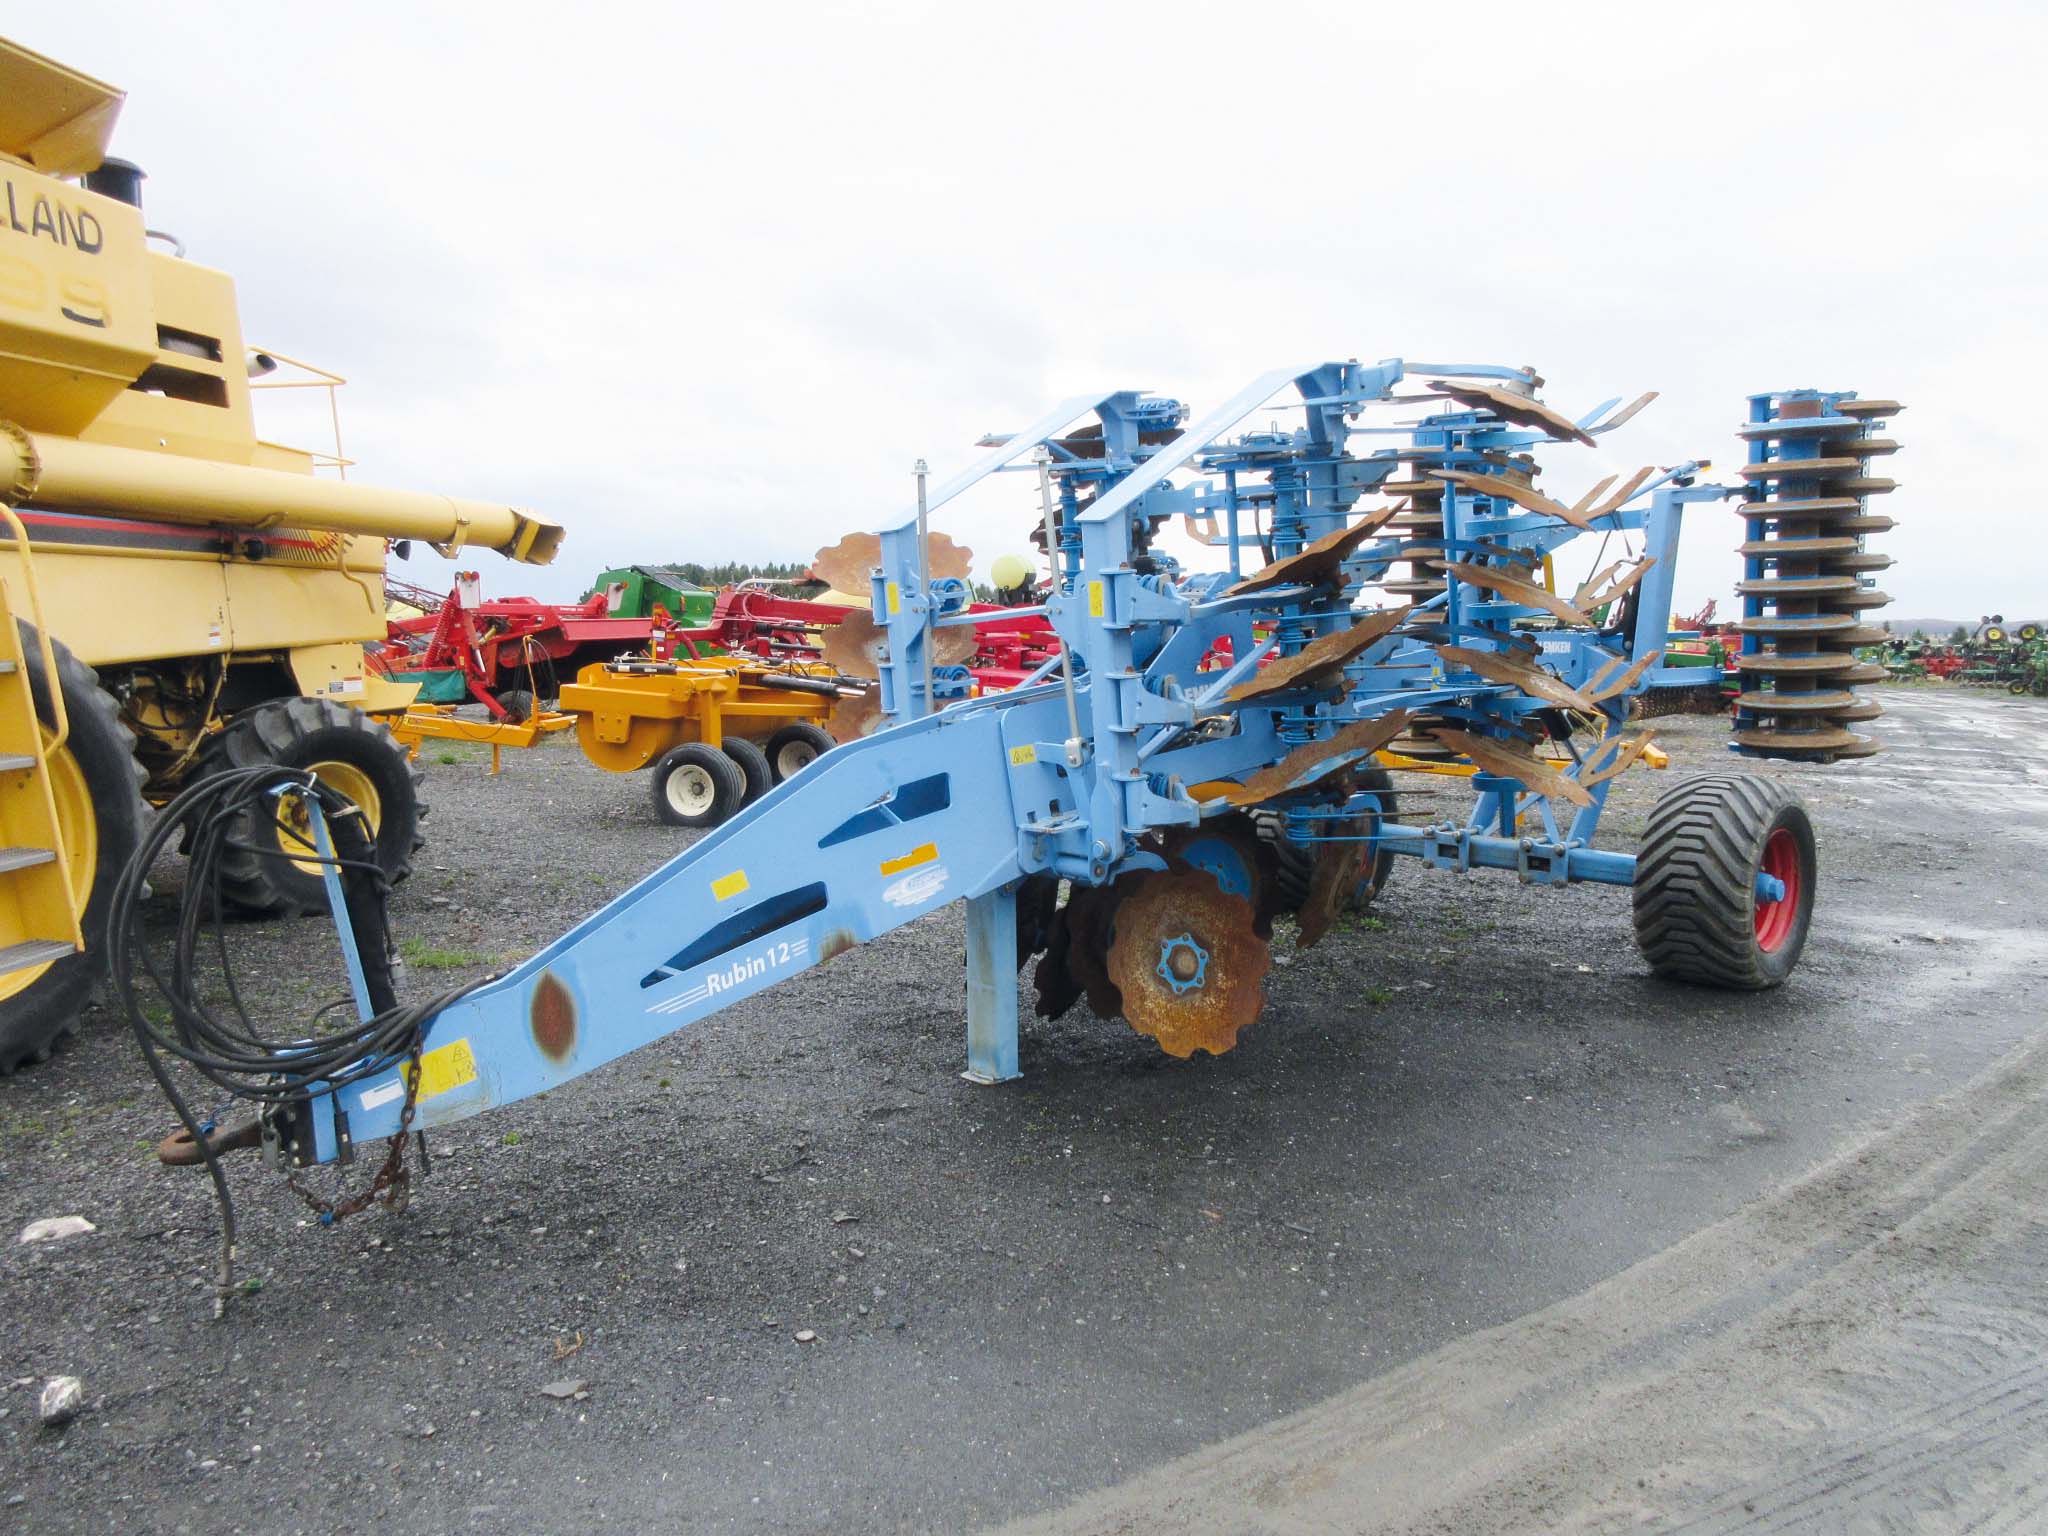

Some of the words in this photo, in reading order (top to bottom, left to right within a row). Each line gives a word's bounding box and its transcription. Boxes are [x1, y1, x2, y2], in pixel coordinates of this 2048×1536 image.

[0, 181, 103, 255] LAND
[707, 956, 766, 997] Rubin
[767, 943, 791, 968] 12
